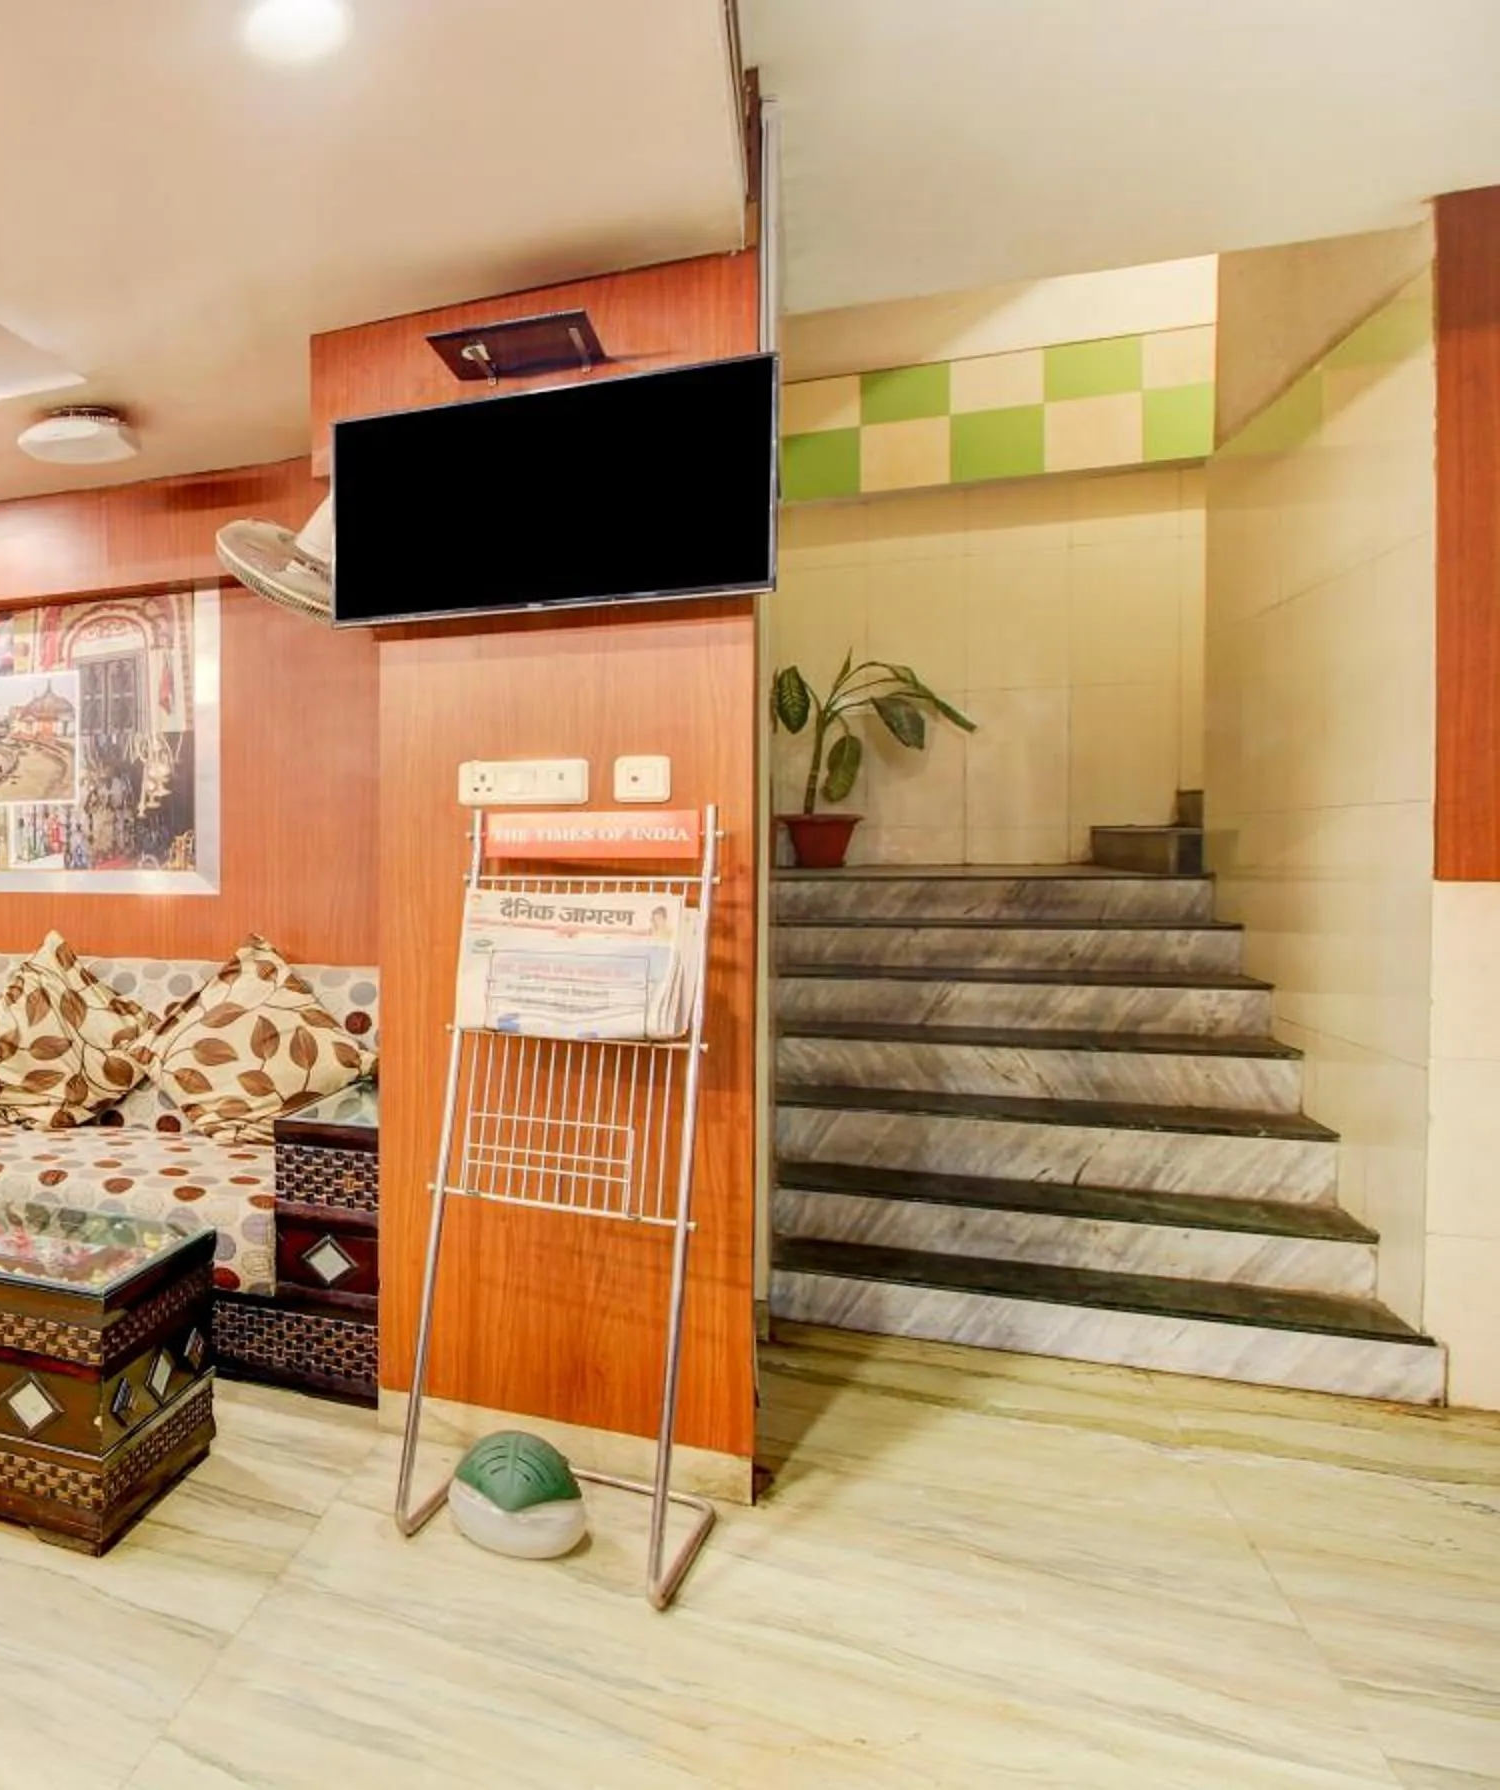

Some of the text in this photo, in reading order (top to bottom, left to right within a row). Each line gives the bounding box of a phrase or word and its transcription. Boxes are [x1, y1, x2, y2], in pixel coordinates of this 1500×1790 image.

[536, 826, 593, 842] TIMES
[632, 827, 690, 842] INDIA
[499, 897, 635, 927] दैनिक जागरण
